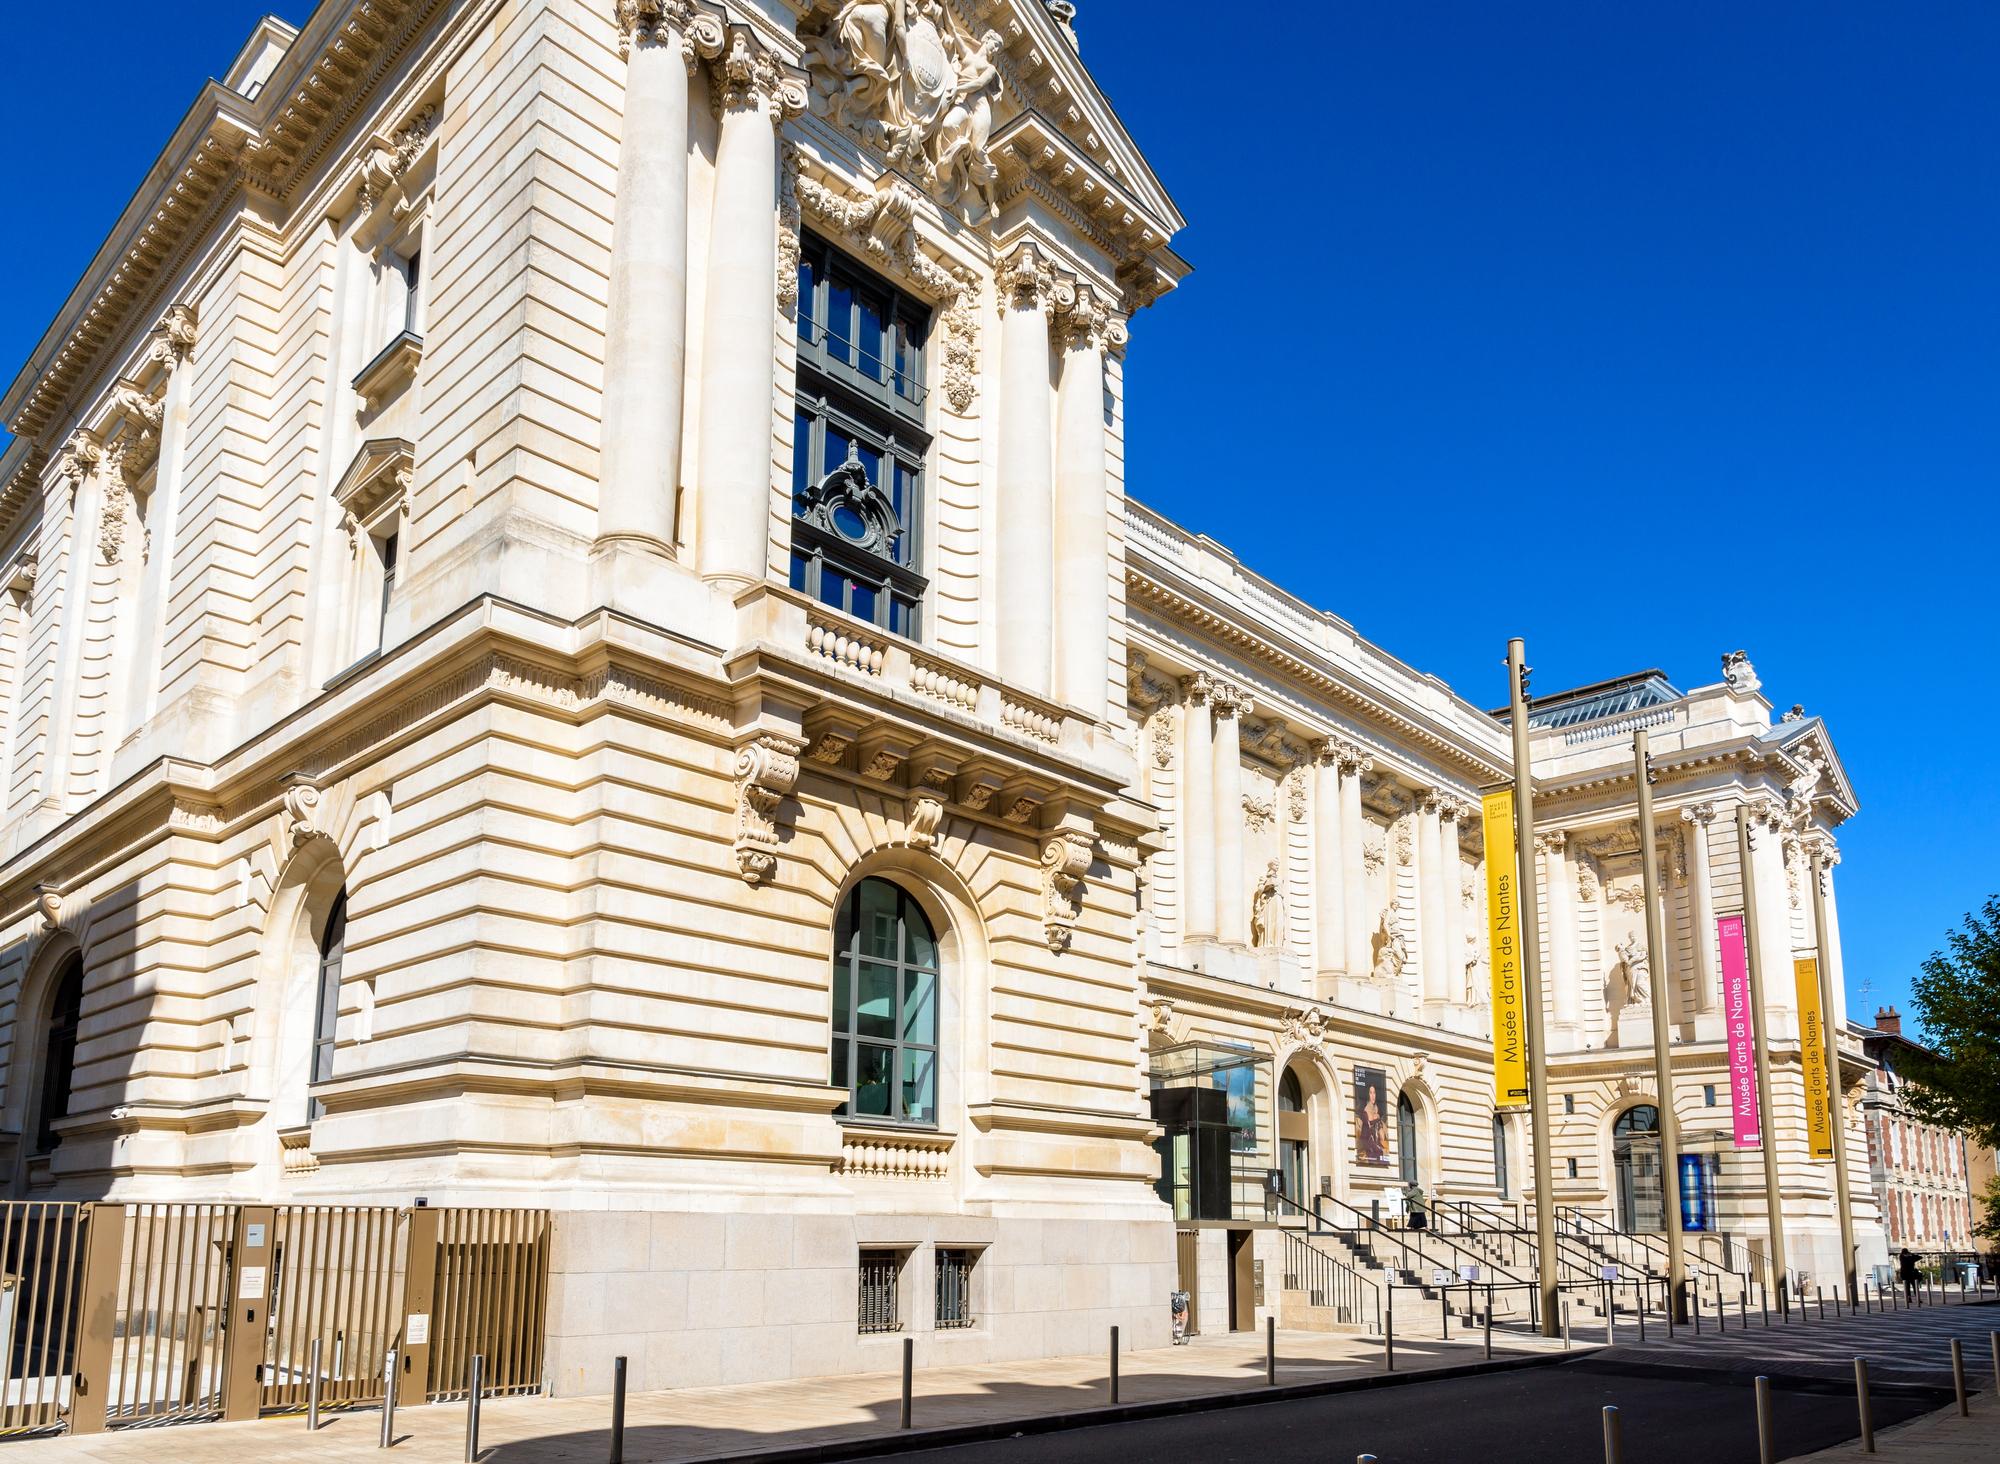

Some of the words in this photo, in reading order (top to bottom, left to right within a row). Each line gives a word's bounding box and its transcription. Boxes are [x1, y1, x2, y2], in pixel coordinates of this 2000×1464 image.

[1496, 874, 1511, 931] Nantes
[1496, 936, 1513, 956] de
[1499, 961, 1515, 1005] d'arts
[1730, 977, 1744, 1019] Nantes
[1501, 1011, 1518, 1063] Musée
[1731, 1022, 1745, 1038] de
[1806, 1010, 1817, 1048] Nantes
[1733, 1041, 1748, 1074] d'arts
[1807, 1050, 1819, 1064] de
[1737, 1077, 1751, 1116] Musée
[1809, 1067, 1822, 1096] d'arts
[1811, 1099, 1825, 1134] Musée
